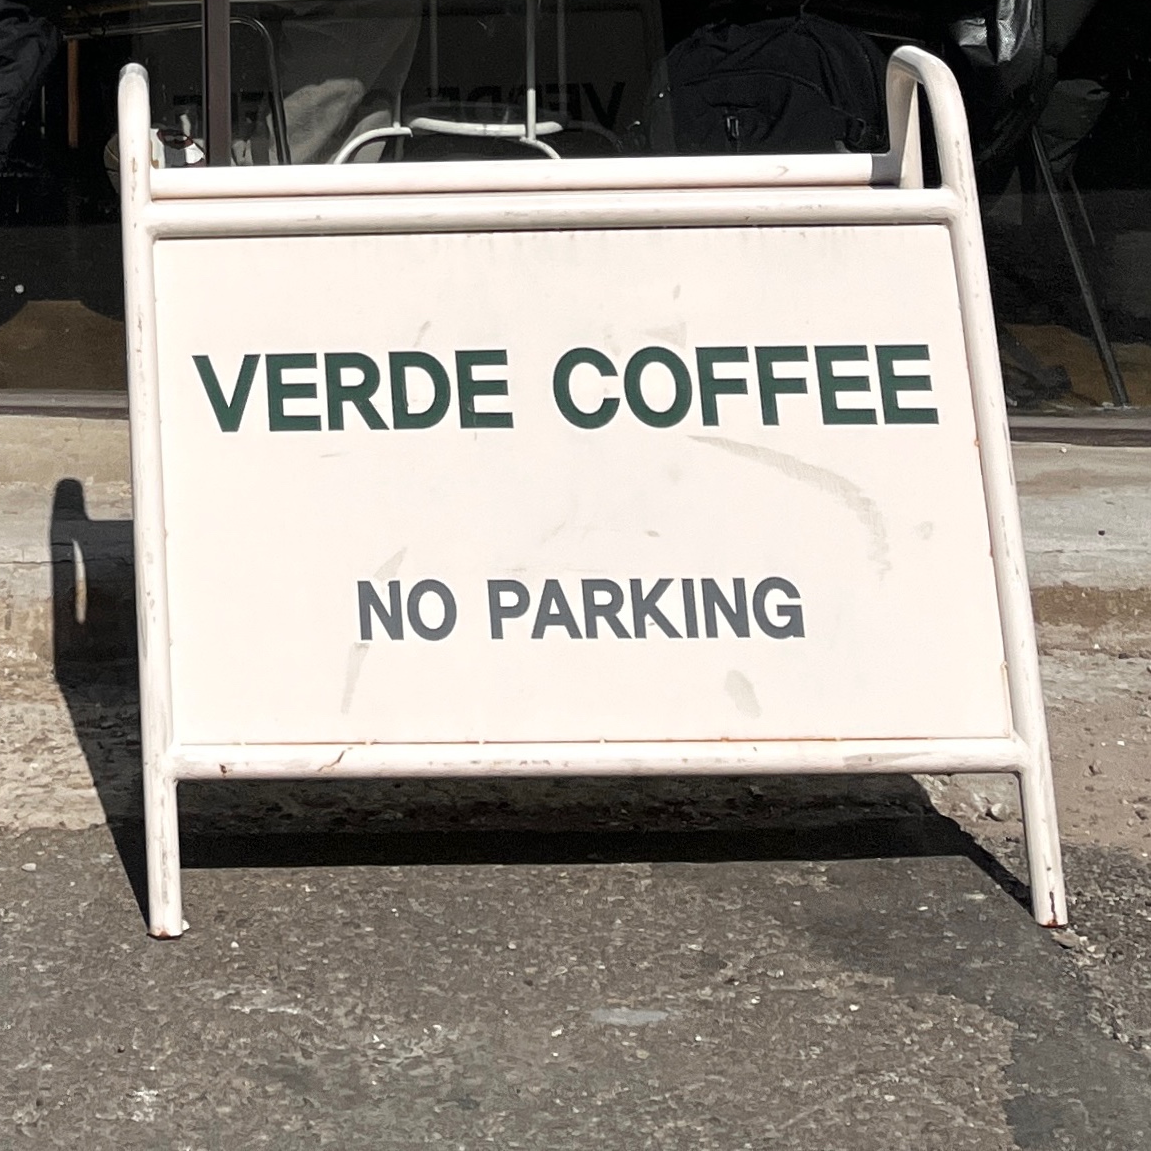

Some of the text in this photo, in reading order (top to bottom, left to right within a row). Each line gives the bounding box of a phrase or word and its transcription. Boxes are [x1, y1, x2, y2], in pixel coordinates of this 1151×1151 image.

[192, 344, 939, 433] VERDE COFFEE
[358, 576, 805, 641] NO PARKING
